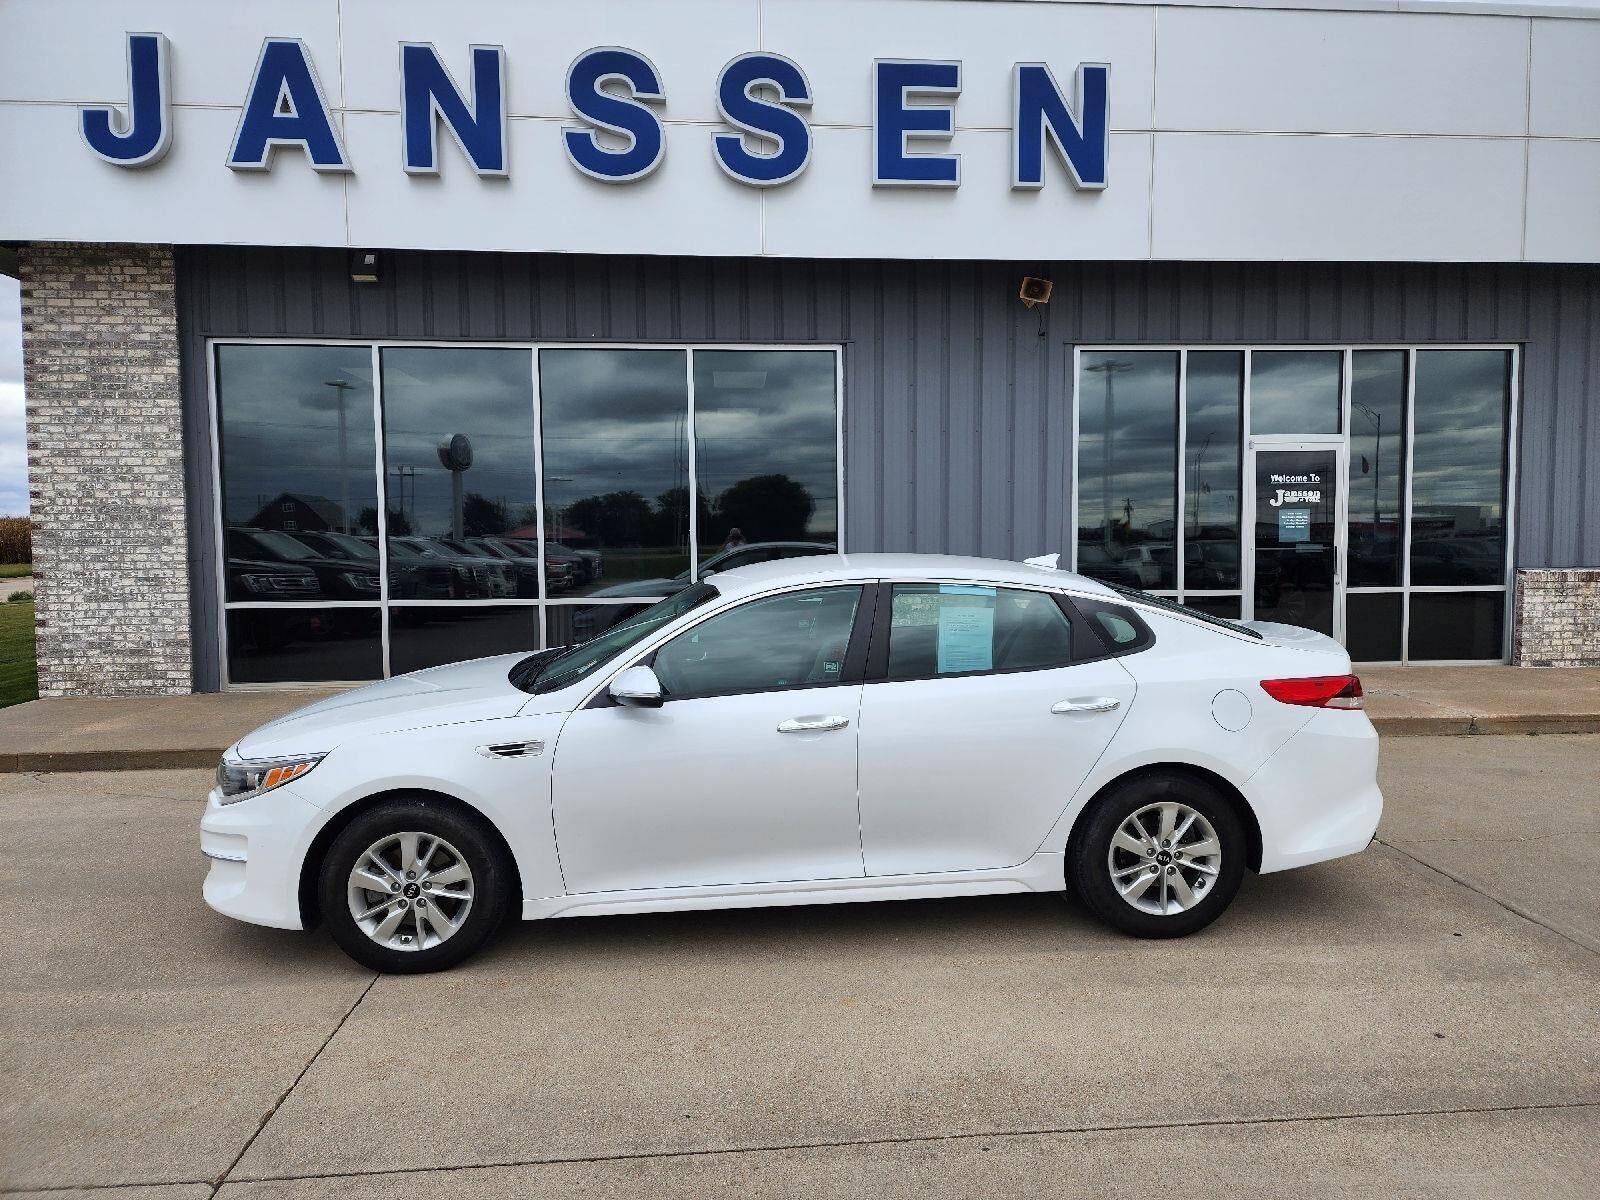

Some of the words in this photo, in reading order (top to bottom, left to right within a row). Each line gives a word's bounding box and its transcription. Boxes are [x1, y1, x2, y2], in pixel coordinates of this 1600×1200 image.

[78, 31, 1111, 191] JANSSEN
[1270, 474, 1308, 482] Welcome
[1309, 473, 1321, 482] To
[1269, 489, 1321, 507] Janssen
[1157, 854, 1170, 863] KIA
[406, 884, 417, 897] KIA
